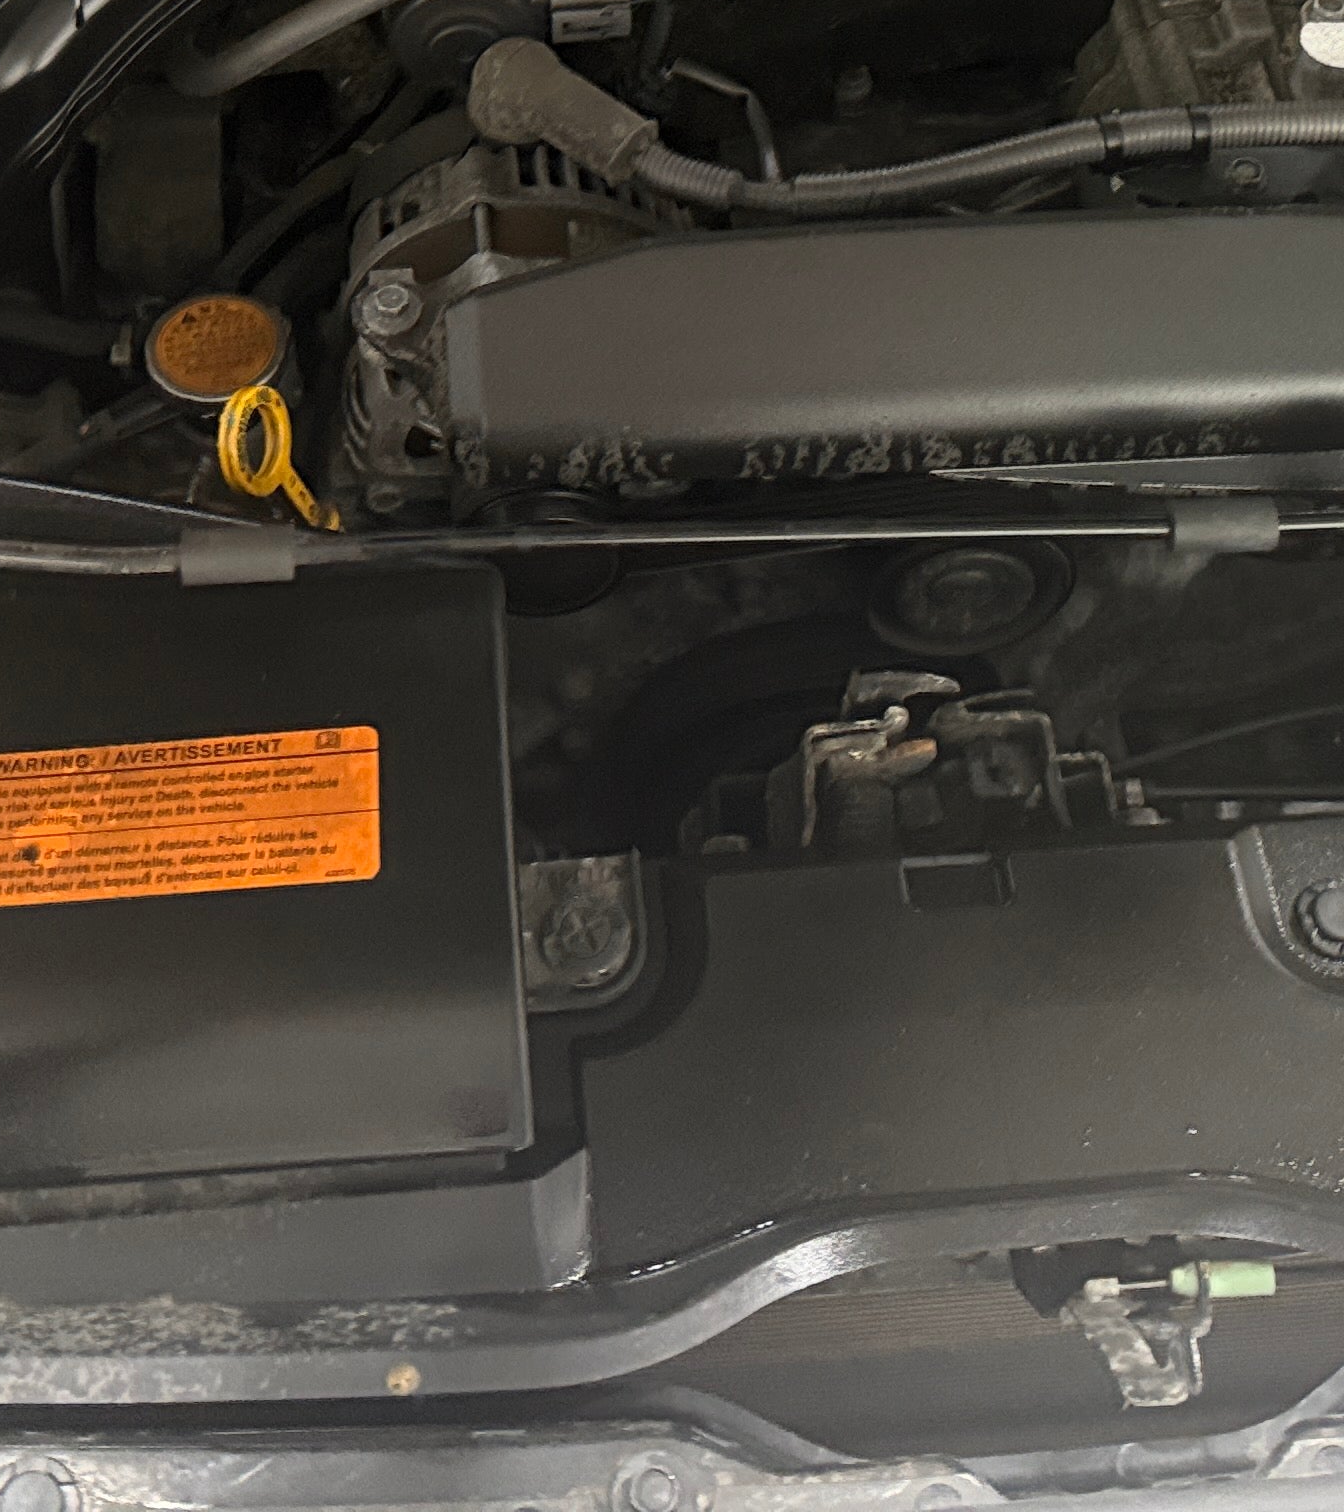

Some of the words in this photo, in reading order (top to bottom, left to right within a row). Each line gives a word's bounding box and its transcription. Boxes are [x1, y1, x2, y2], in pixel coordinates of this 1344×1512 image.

[114, 738, 282, 765] AVERTISSEMENT
[6, 801, 30, 812] risk
[35, 800, 47, 810] of
[50, 797, 95, 809] serious
[139, 794, 152, 803] or
[199, 783, 268, 798] disconnect
[272, 782, 290, 793] the
[296, 777, 339, 790] vehicle
[13, 781, 71, 799] equipped
[75, 779, 100, 792] with
[115, 776, 158, 789] remote
[162, 769, 225, 786] controlled
[228, 767, 271, 783] engine
[8, 813, 76, 830] performing
[82, 813, 104, 825] any
[107, 807, 152, 820] service
[156, 808, 172, 816] on
[176, 804, 195, 815] the
[217, 834, 246, 846] Pour
[299, 827, 317, 840] les
[47, 863, 90, 877] graves
[94, 861, 111, 871] ou
[268, 845, 316, 858] batterie
[320, 842, 337, 855] du
[77, 877, 99, 889] des
[225, 867, 247, 878] sur
